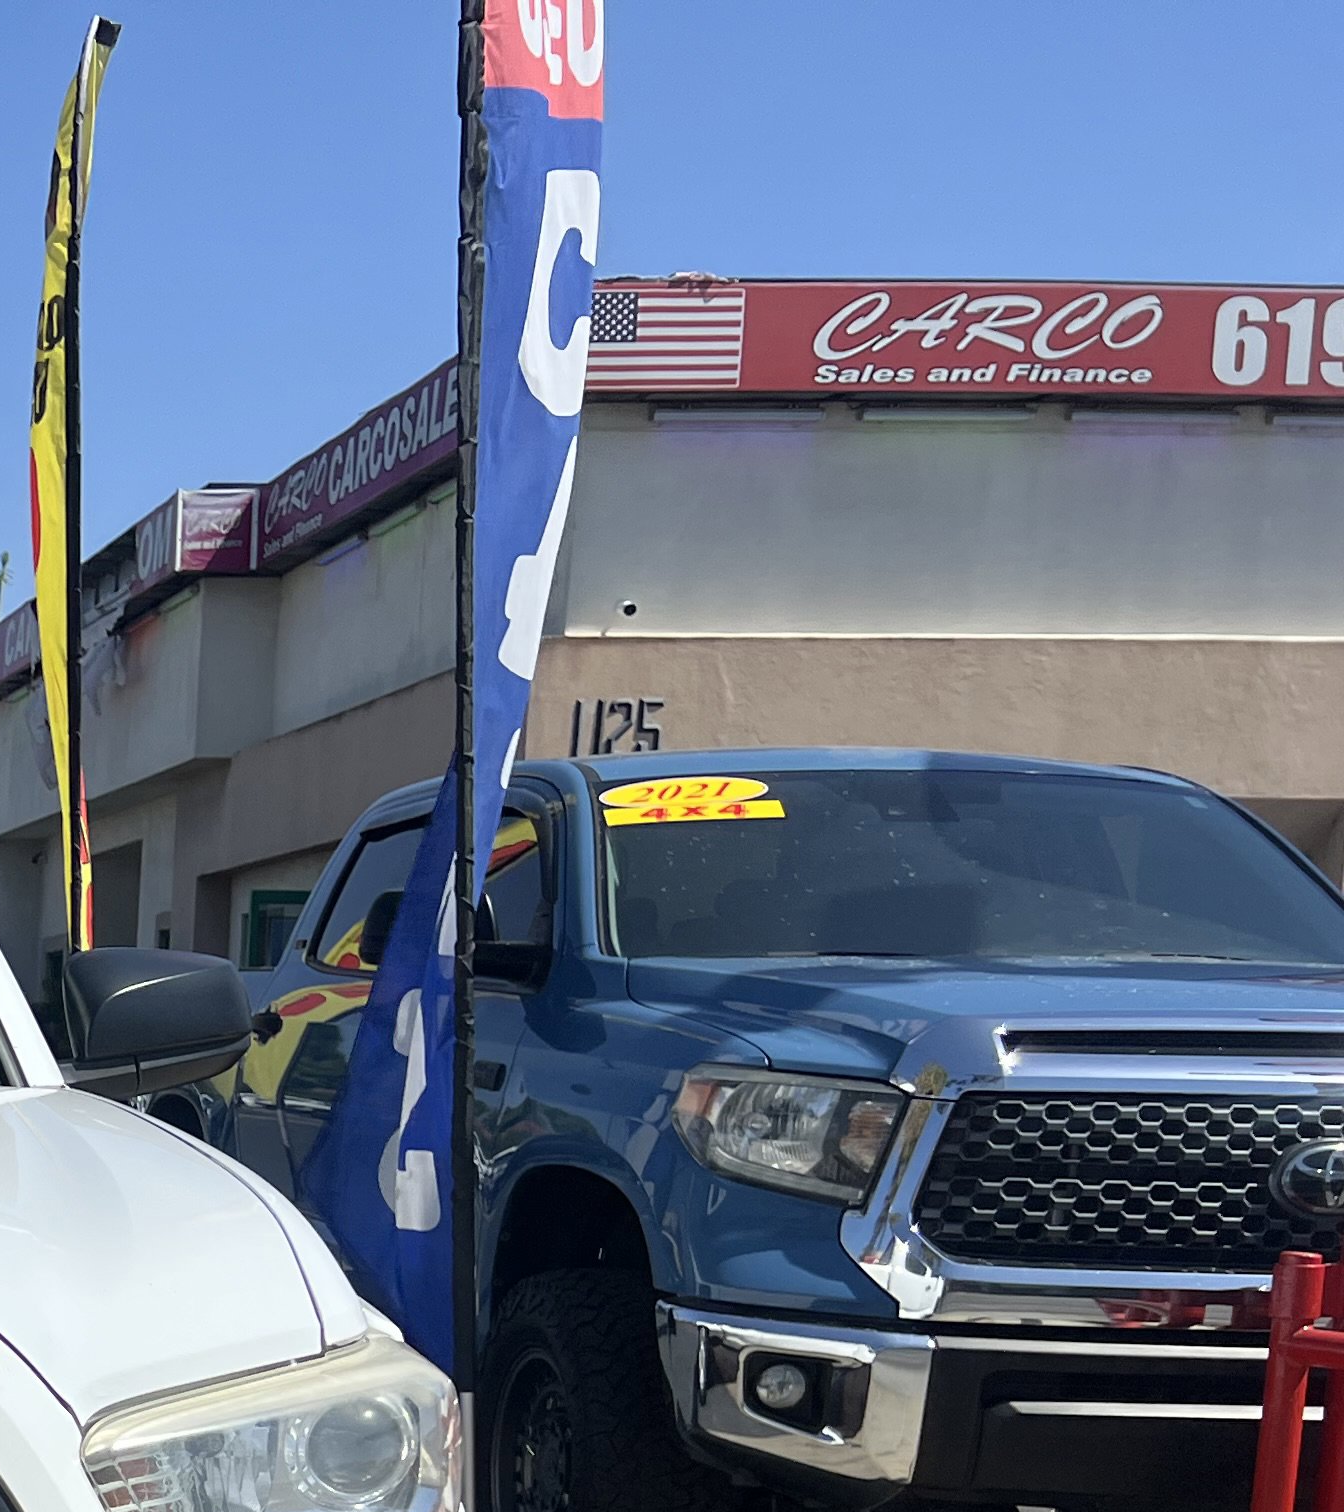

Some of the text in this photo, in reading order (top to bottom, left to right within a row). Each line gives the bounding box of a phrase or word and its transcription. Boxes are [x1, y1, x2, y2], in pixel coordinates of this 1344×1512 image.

[812, 290, 1165, 361] CARCO
[813, 363, 1154, 384] Sales and Finance
[264, 452, 328, 535] CARCO
[570, 699, 664, 758] 1125
[631, 781, 732, 804] 2021
